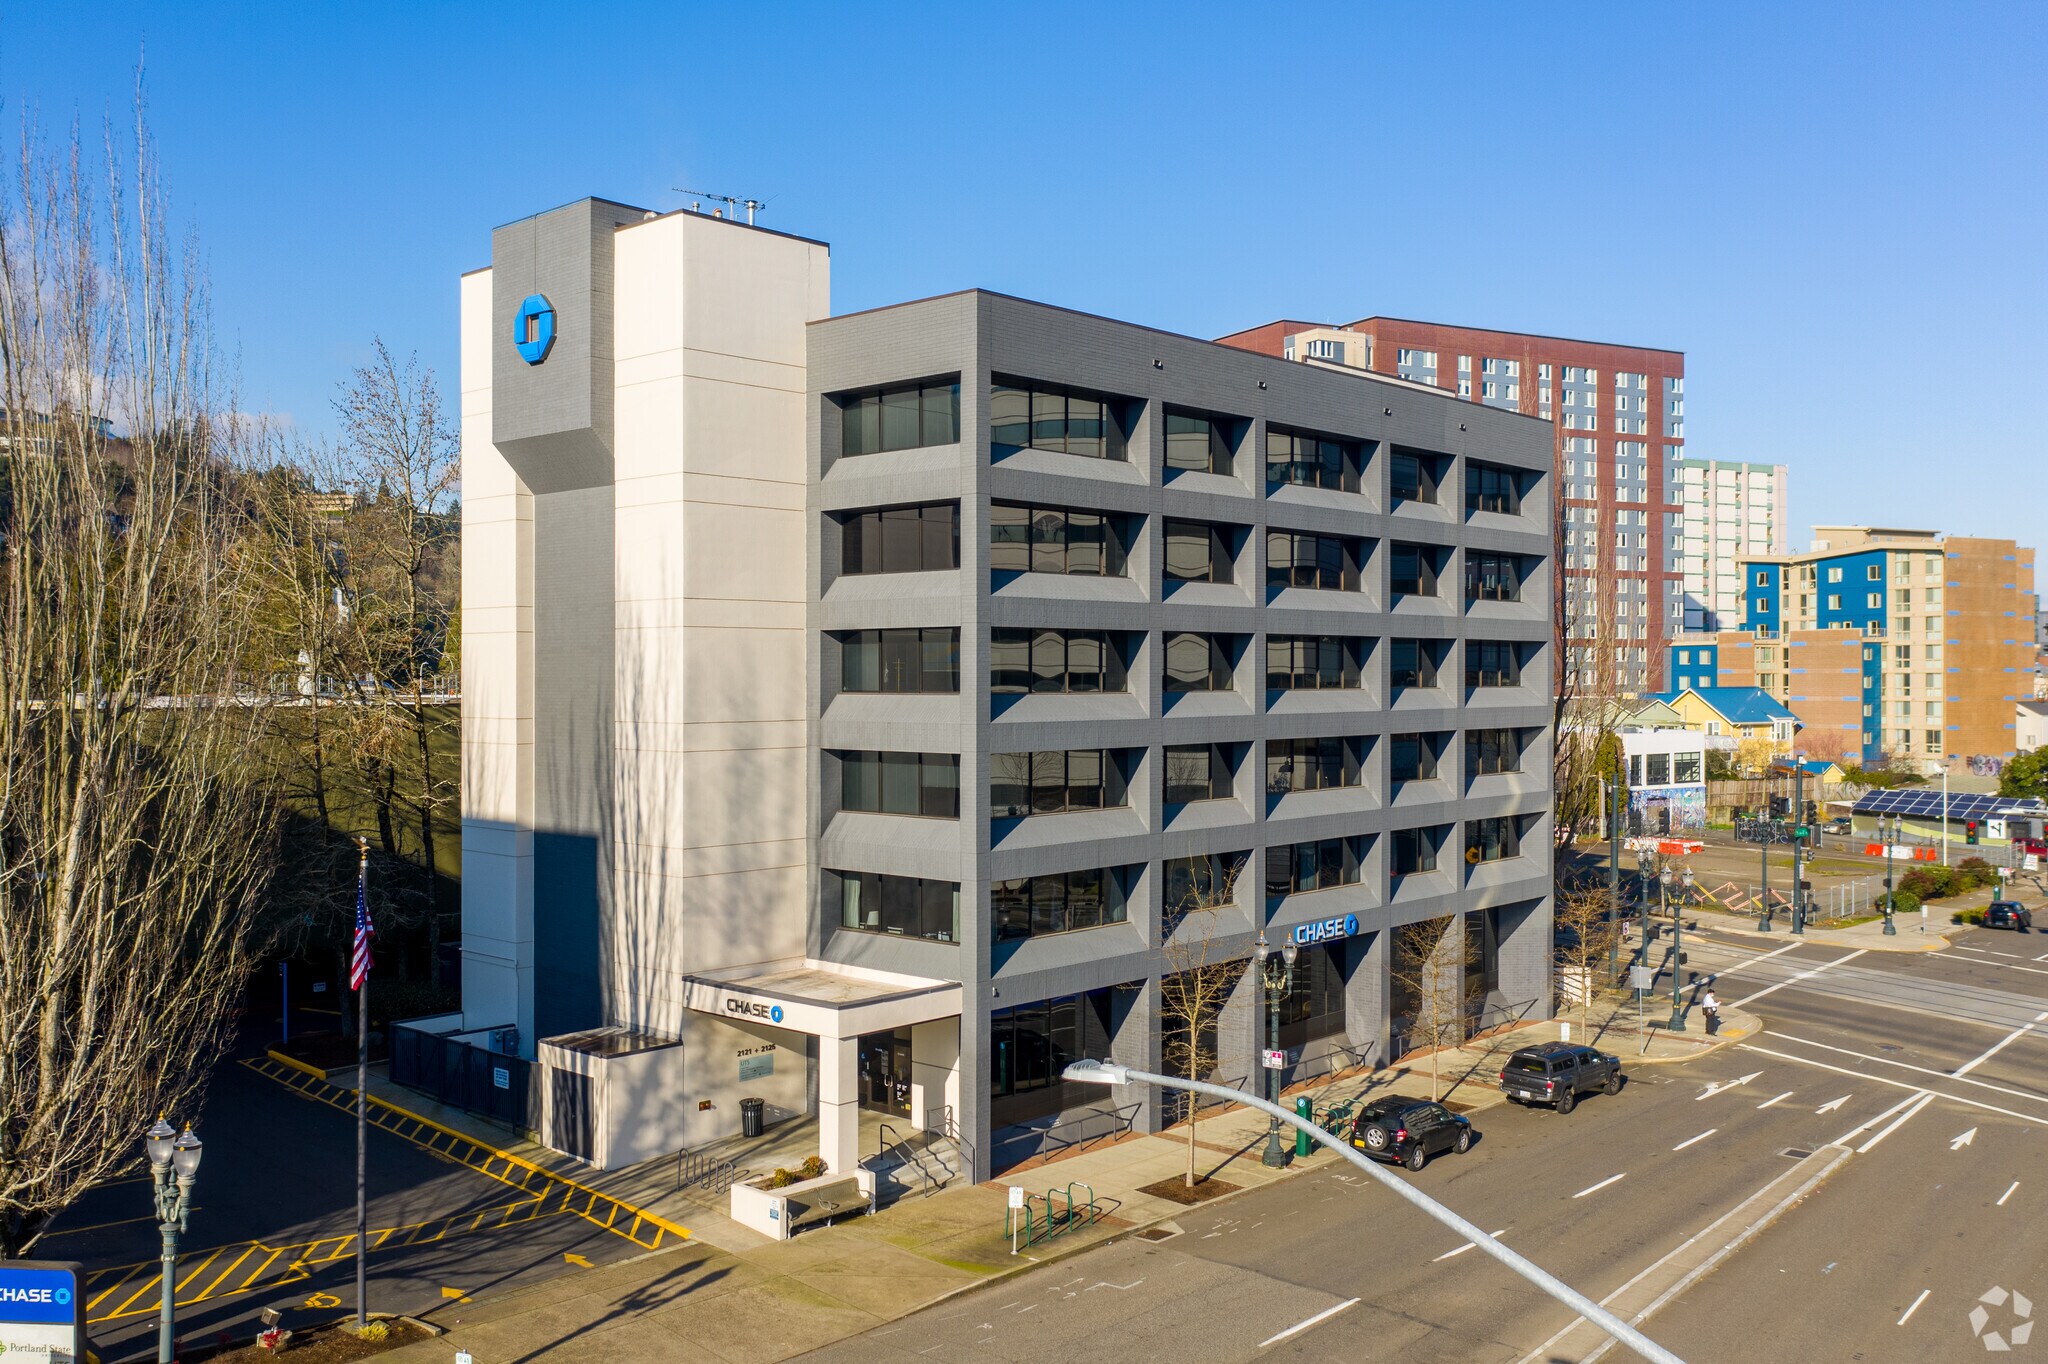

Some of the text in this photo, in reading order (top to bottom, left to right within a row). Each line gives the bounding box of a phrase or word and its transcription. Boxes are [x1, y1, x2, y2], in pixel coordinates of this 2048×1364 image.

[1295, 918, 1344, 943] CHASE
[726, 998, 771, 1020] CHASE
[737, 1048, 752, 1057] 2121
[0, 1287, 53, 1303] HASE
[10, 1342, 72, 1354] Portland State
